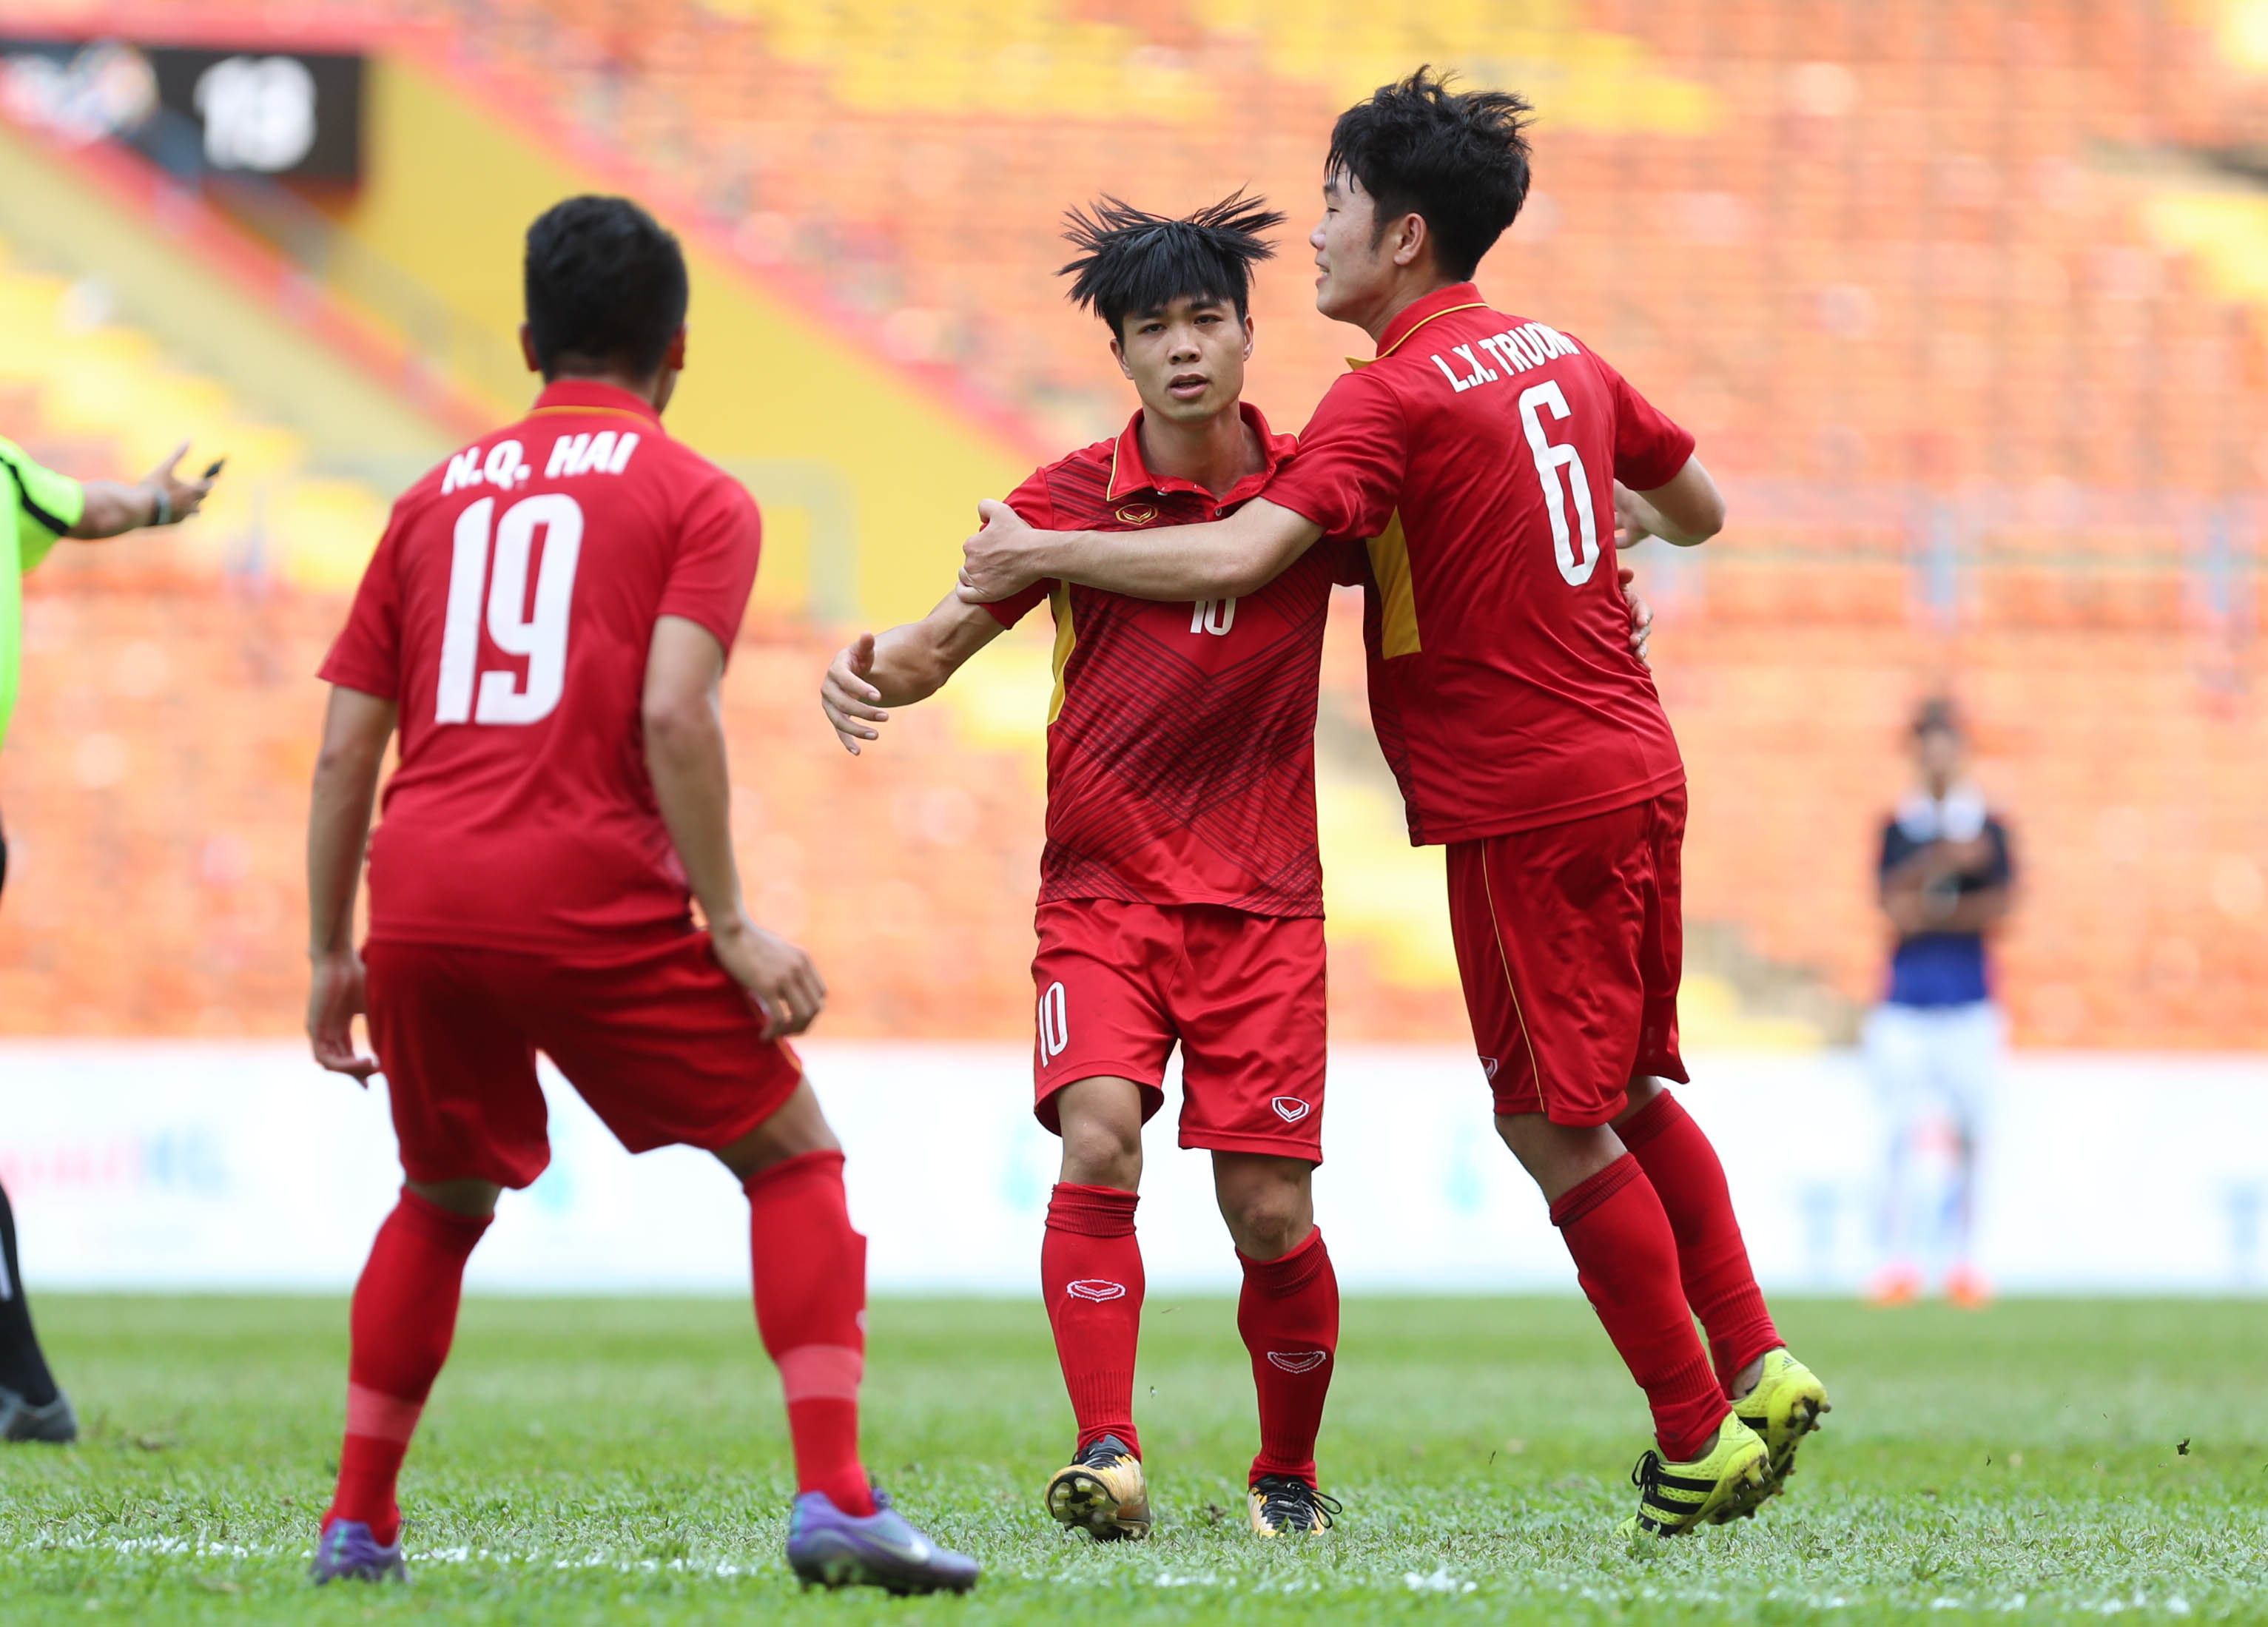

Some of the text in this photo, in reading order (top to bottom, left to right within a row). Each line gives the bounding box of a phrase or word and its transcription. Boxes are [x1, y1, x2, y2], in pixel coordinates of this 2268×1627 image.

[440, 430, 641, 496] N.Q. HAI
[1518, 379, 1601, 587] 6
[434, 493, 585, 725] 19
[1037, 981, 1069, 1068] 10
